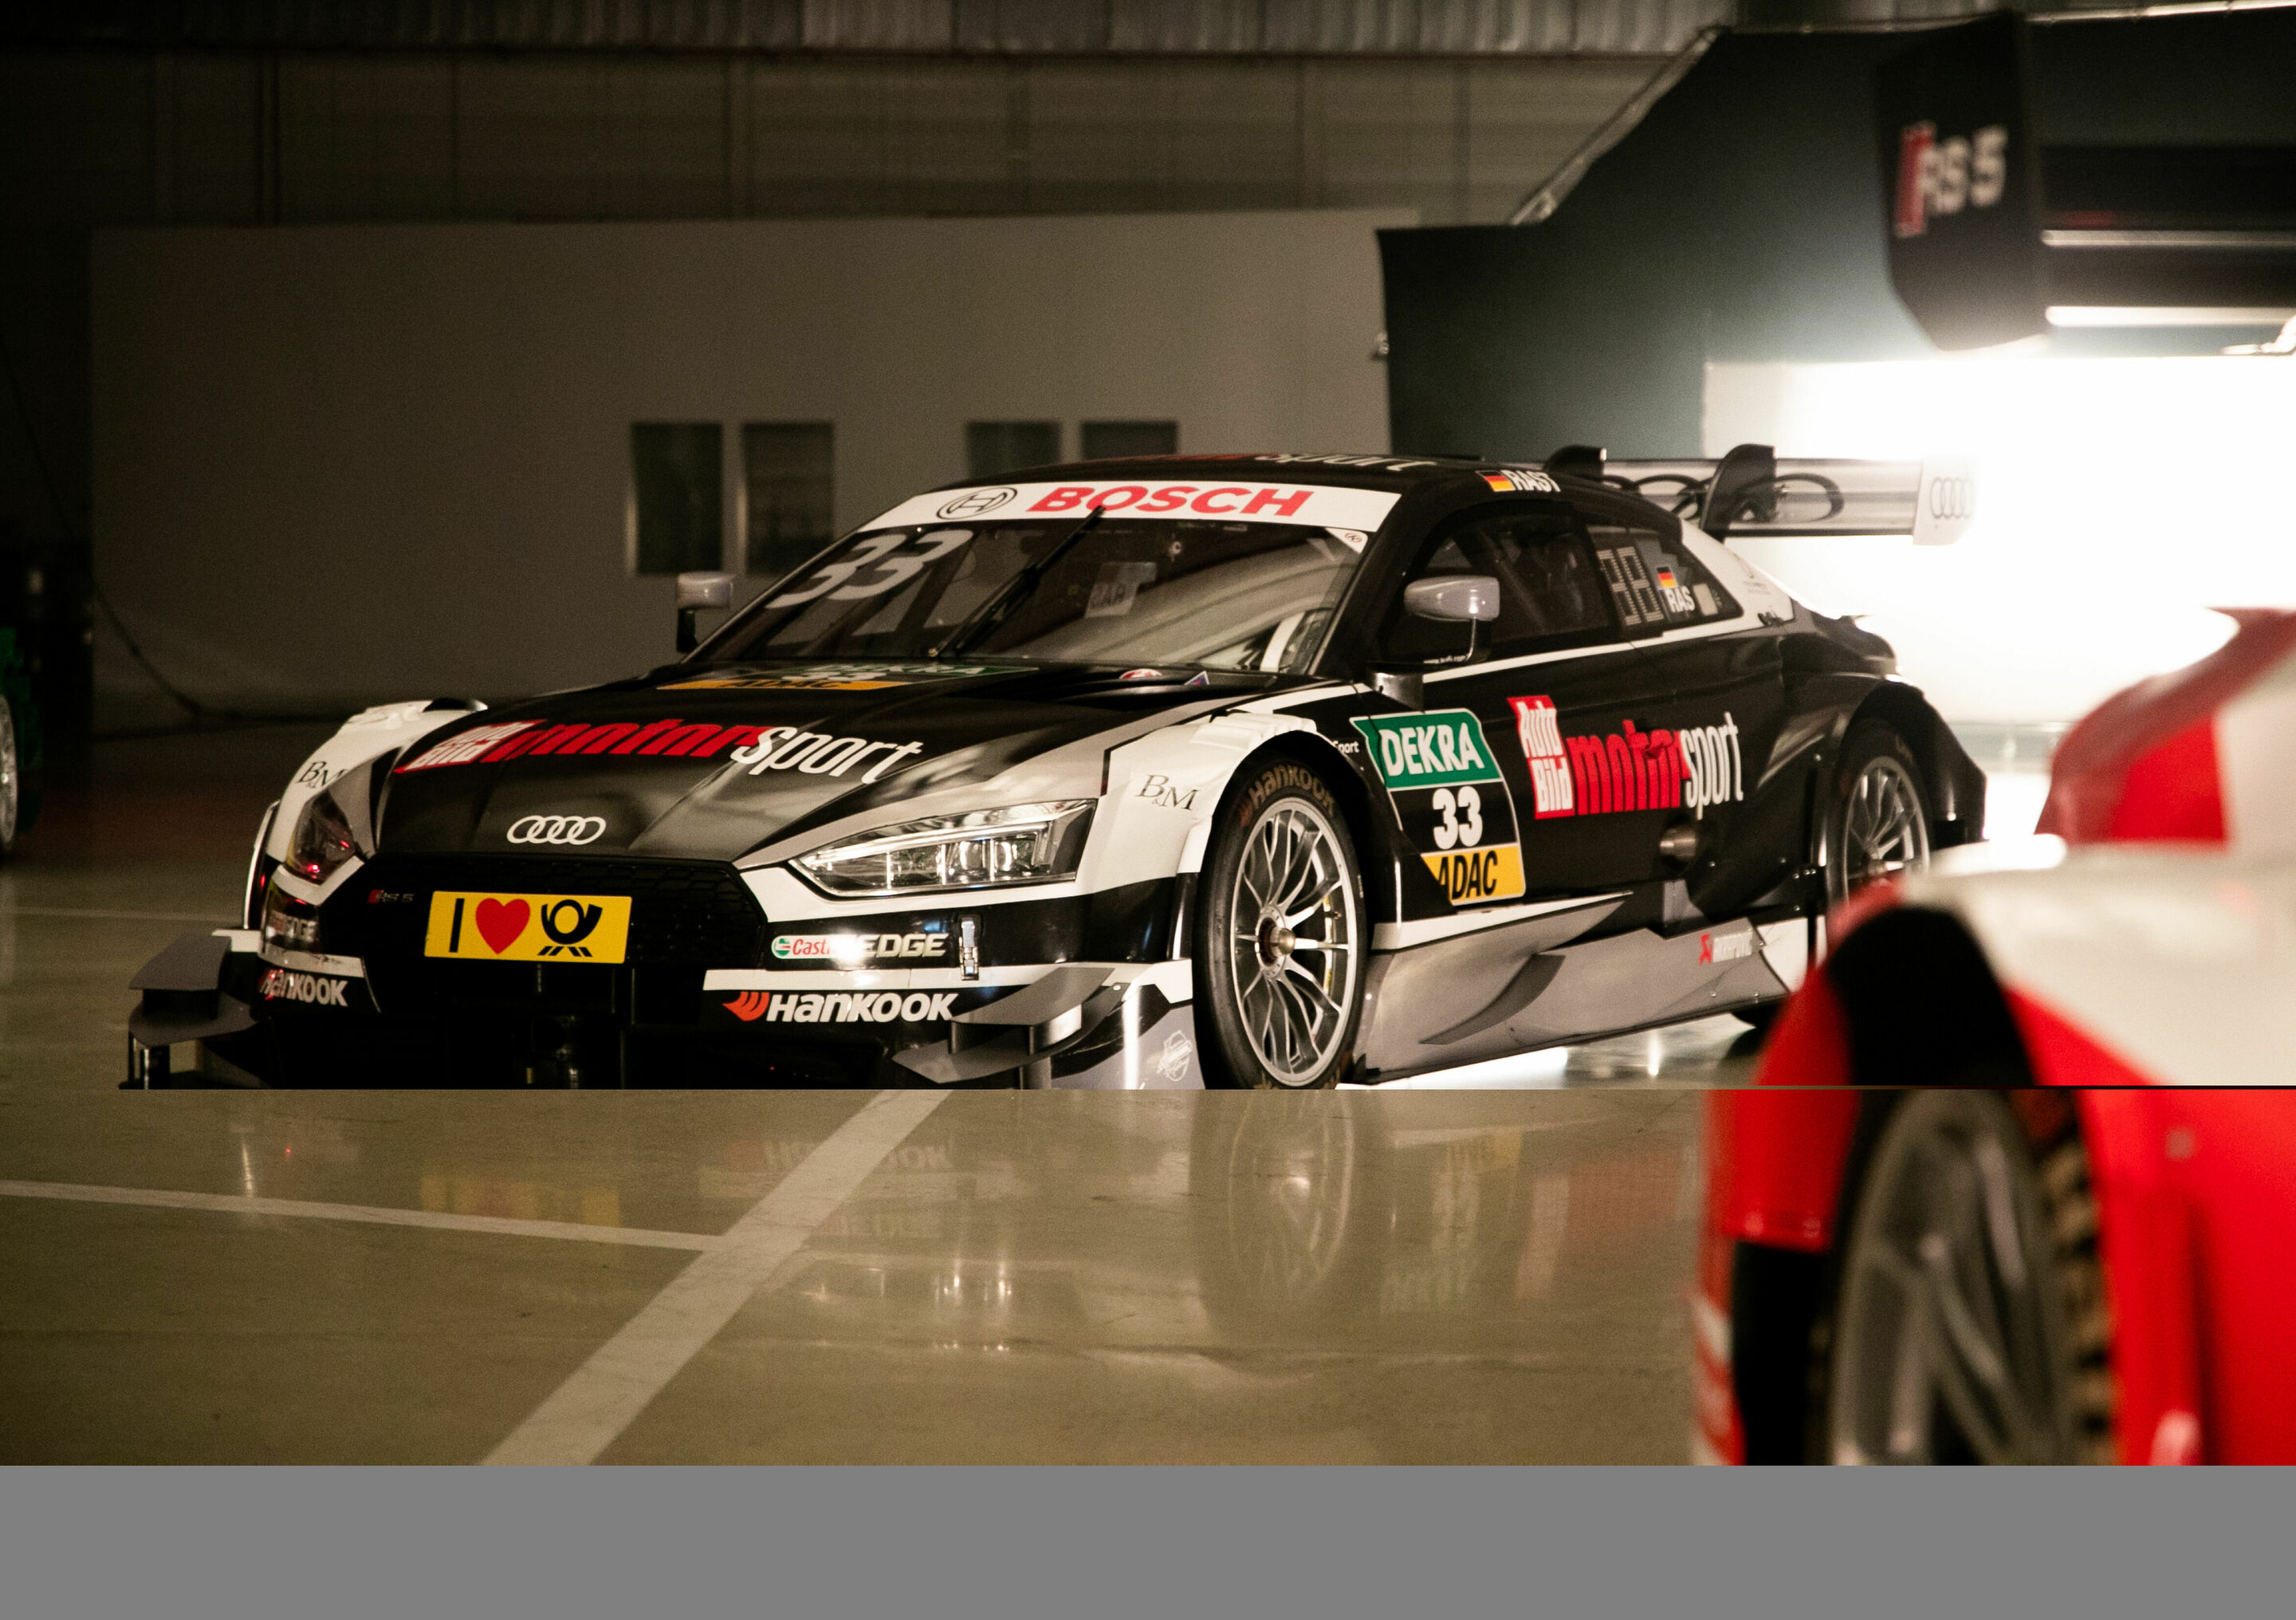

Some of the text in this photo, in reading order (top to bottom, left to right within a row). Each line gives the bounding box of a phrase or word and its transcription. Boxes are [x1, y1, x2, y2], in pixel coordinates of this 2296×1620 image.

[1025, 485, 1315, 517] BOSCH
[1500, 470, 1561, 493] RAST
[764, 529, 974, 609] 33
[1378, 722, 1484, 777] DEKRA
[1516, 701, 1563, 757] Auto
[1530, 757, 1573, 812] Bild
[1432, 785, 1483, 850] 33
[449, 898, 464, 953] I
[861, 933, 949, 957] EDGE
